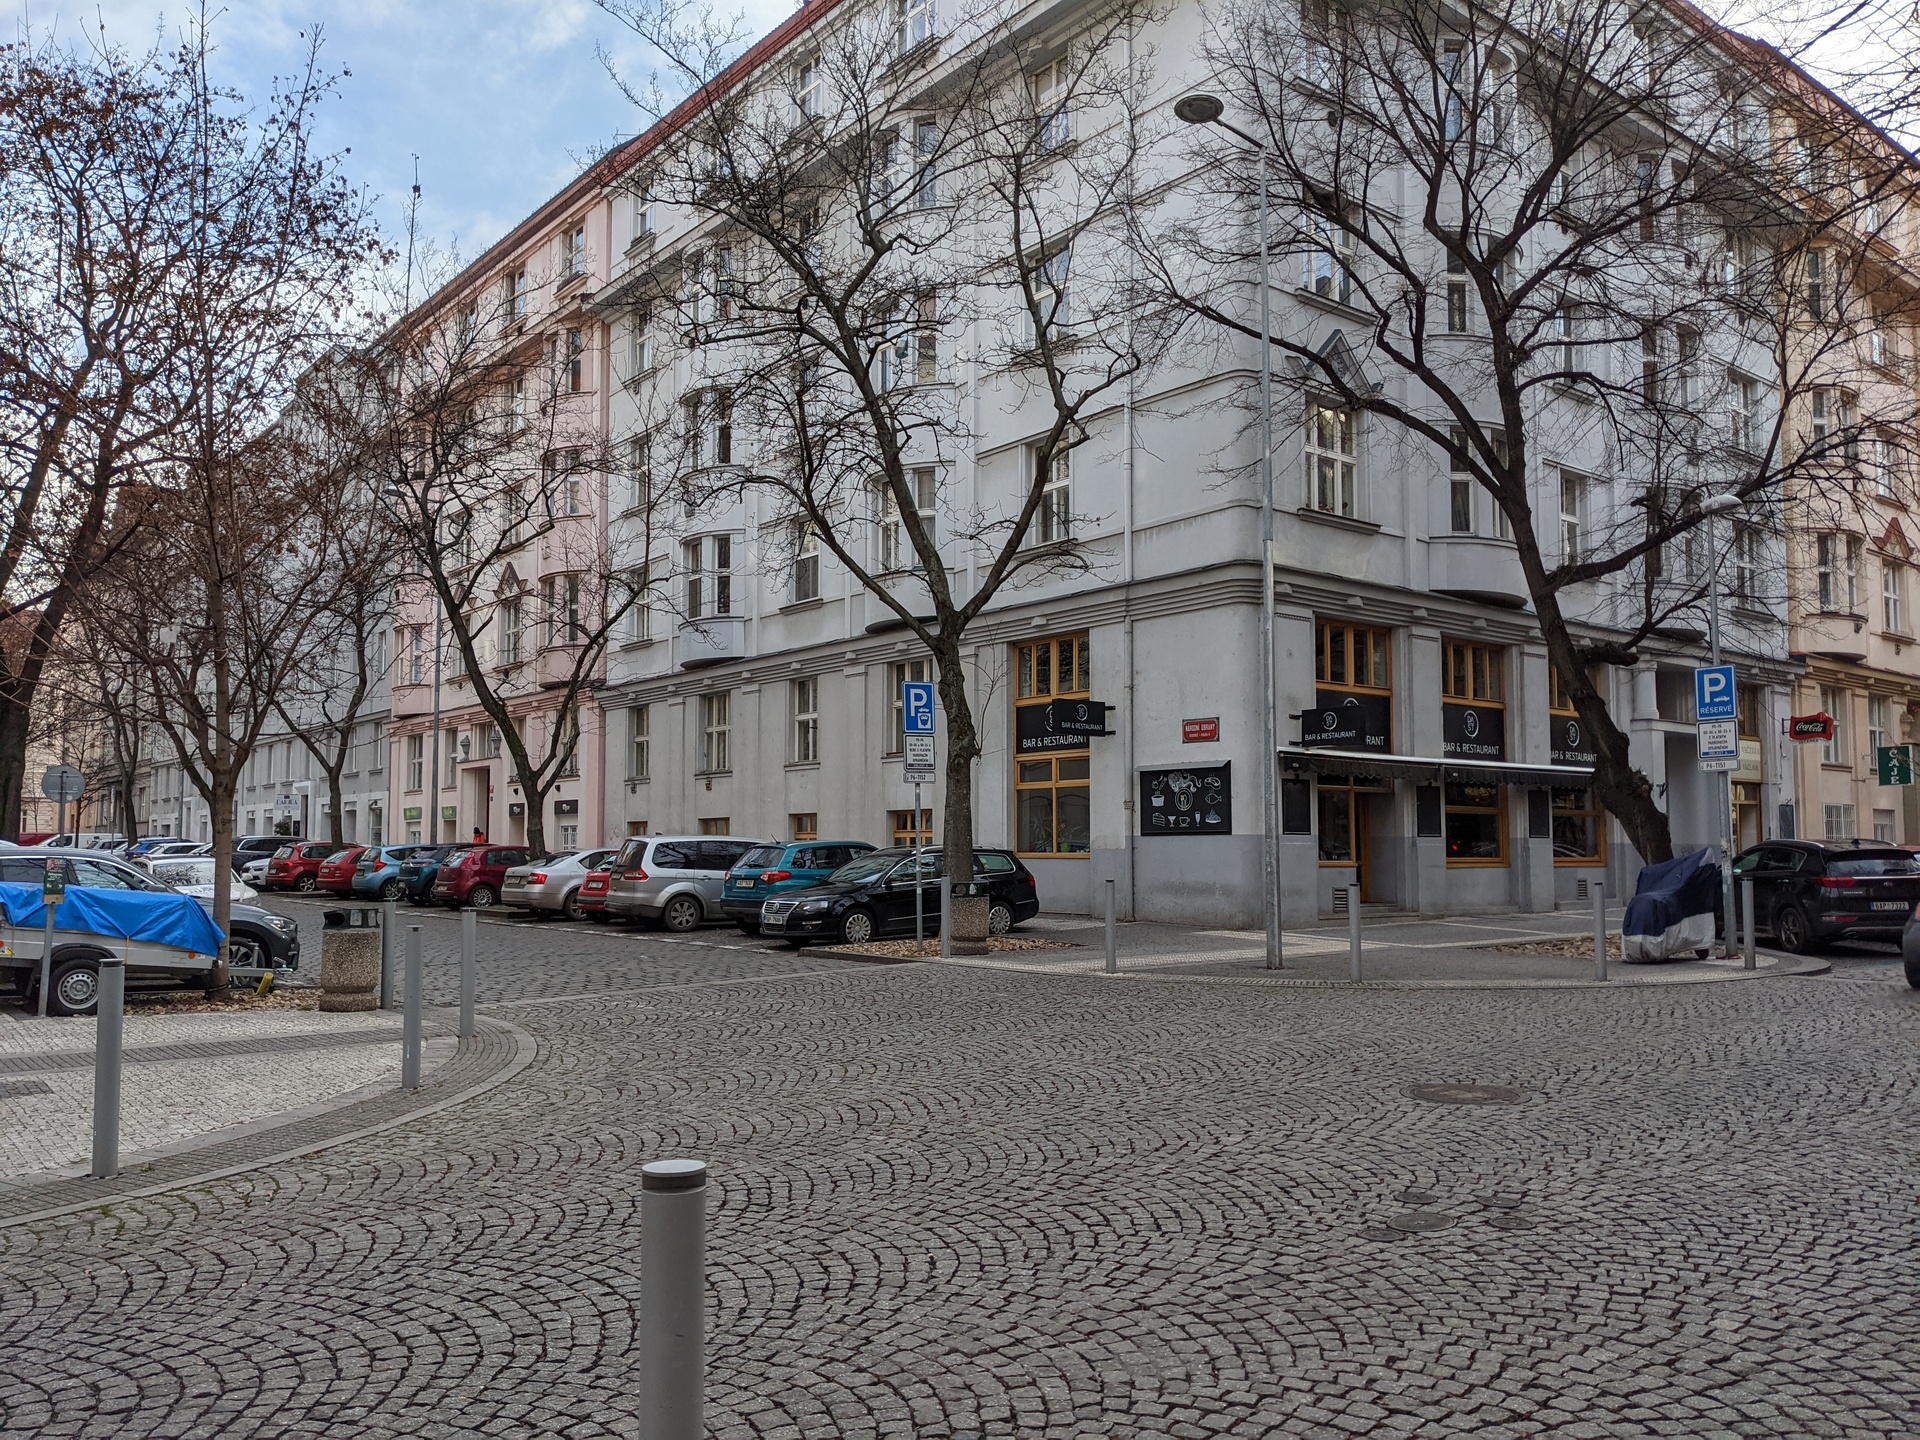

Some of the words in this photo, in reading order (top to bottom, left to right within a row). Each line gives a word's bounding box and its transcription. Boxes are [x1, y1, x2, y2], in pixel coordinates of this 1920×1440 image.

[1704, 673, 1726, 704] P
[910, 688, 927, 716] P
[1700, 704, 1732, 714] RÉSERVÉ
[1322, 731, 1356, 739] RESTAURANT
[1023, 738, 1036, 748] BAR
[1037, 738, 1042, 746] &
[1443, 742, 1455, 752] BAR
[1456, 743, 1460, 752] &
[1463, 743, 1499, 755] RESTAURANT
[1560, 751, 1563, 759] &
[1566, 751, 1597, 762] RESTAURANT
[1889, 748, 1899, 784] ČAJE
